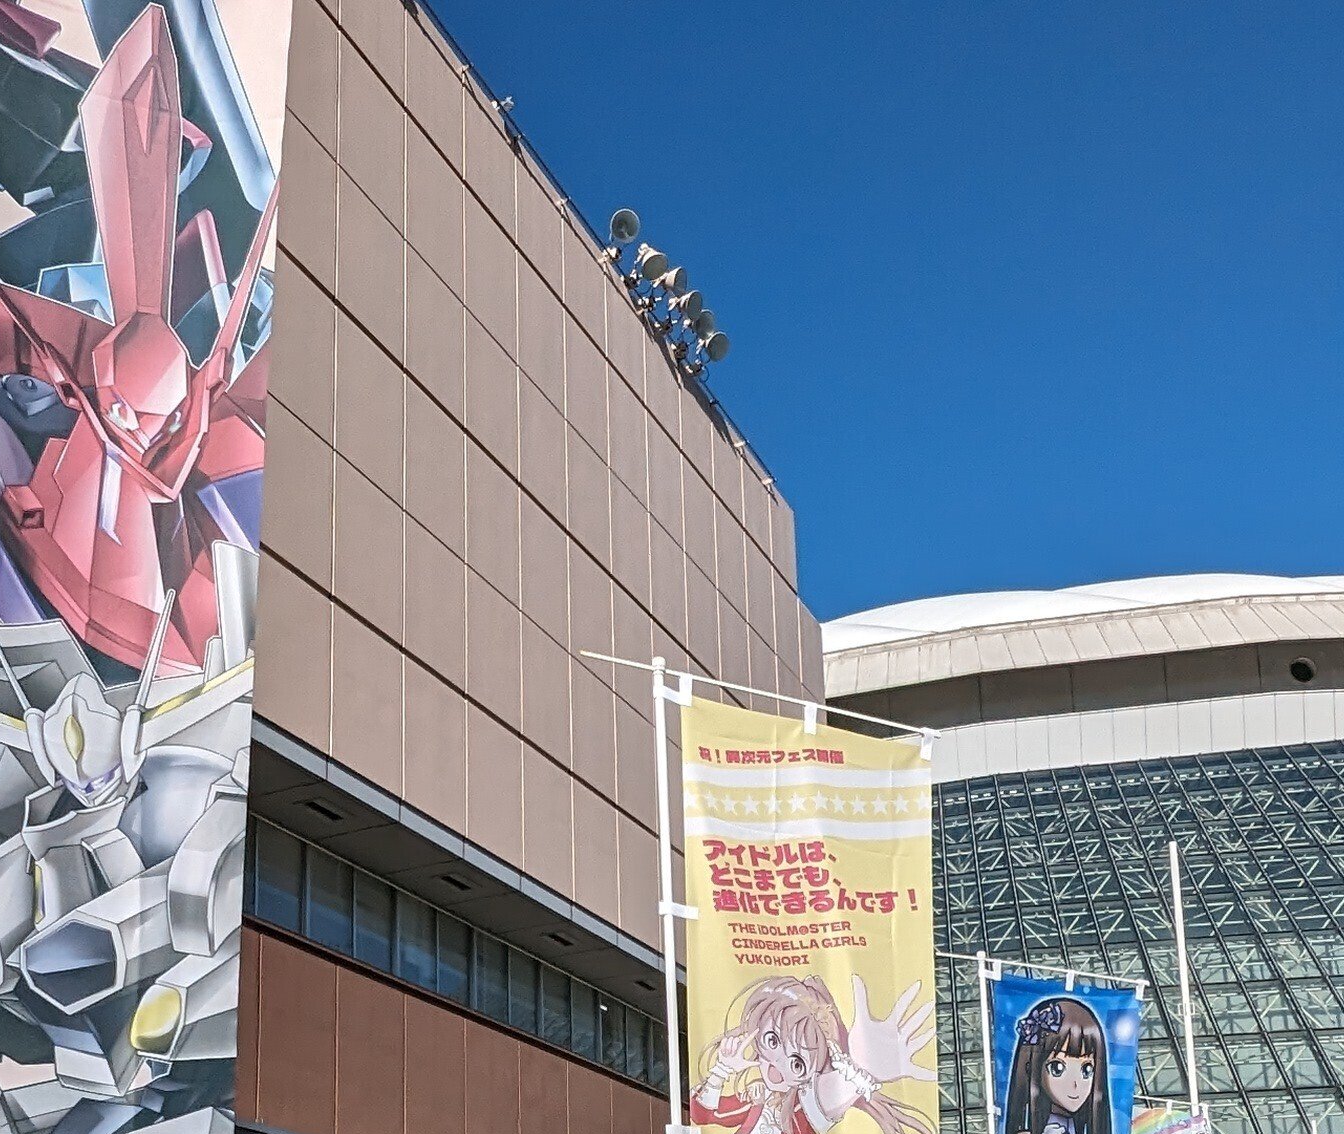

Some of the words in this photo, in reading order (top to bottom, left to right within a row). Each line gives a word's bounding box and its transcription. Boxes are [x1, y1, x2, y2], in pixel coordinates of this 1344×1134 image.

[702, 840, 837, 867] アイドルは、
[709, 864, 842, 890] どこまでも、
[712, 888, 919, 916] 進化できるんです!
[728, 922, 756, 935] THE
[757, 921, 851, 936] IDOLM@STER
[732, 937, 819, 950] CINDERELLA
[821, 936, 867, 949] GIRLS
